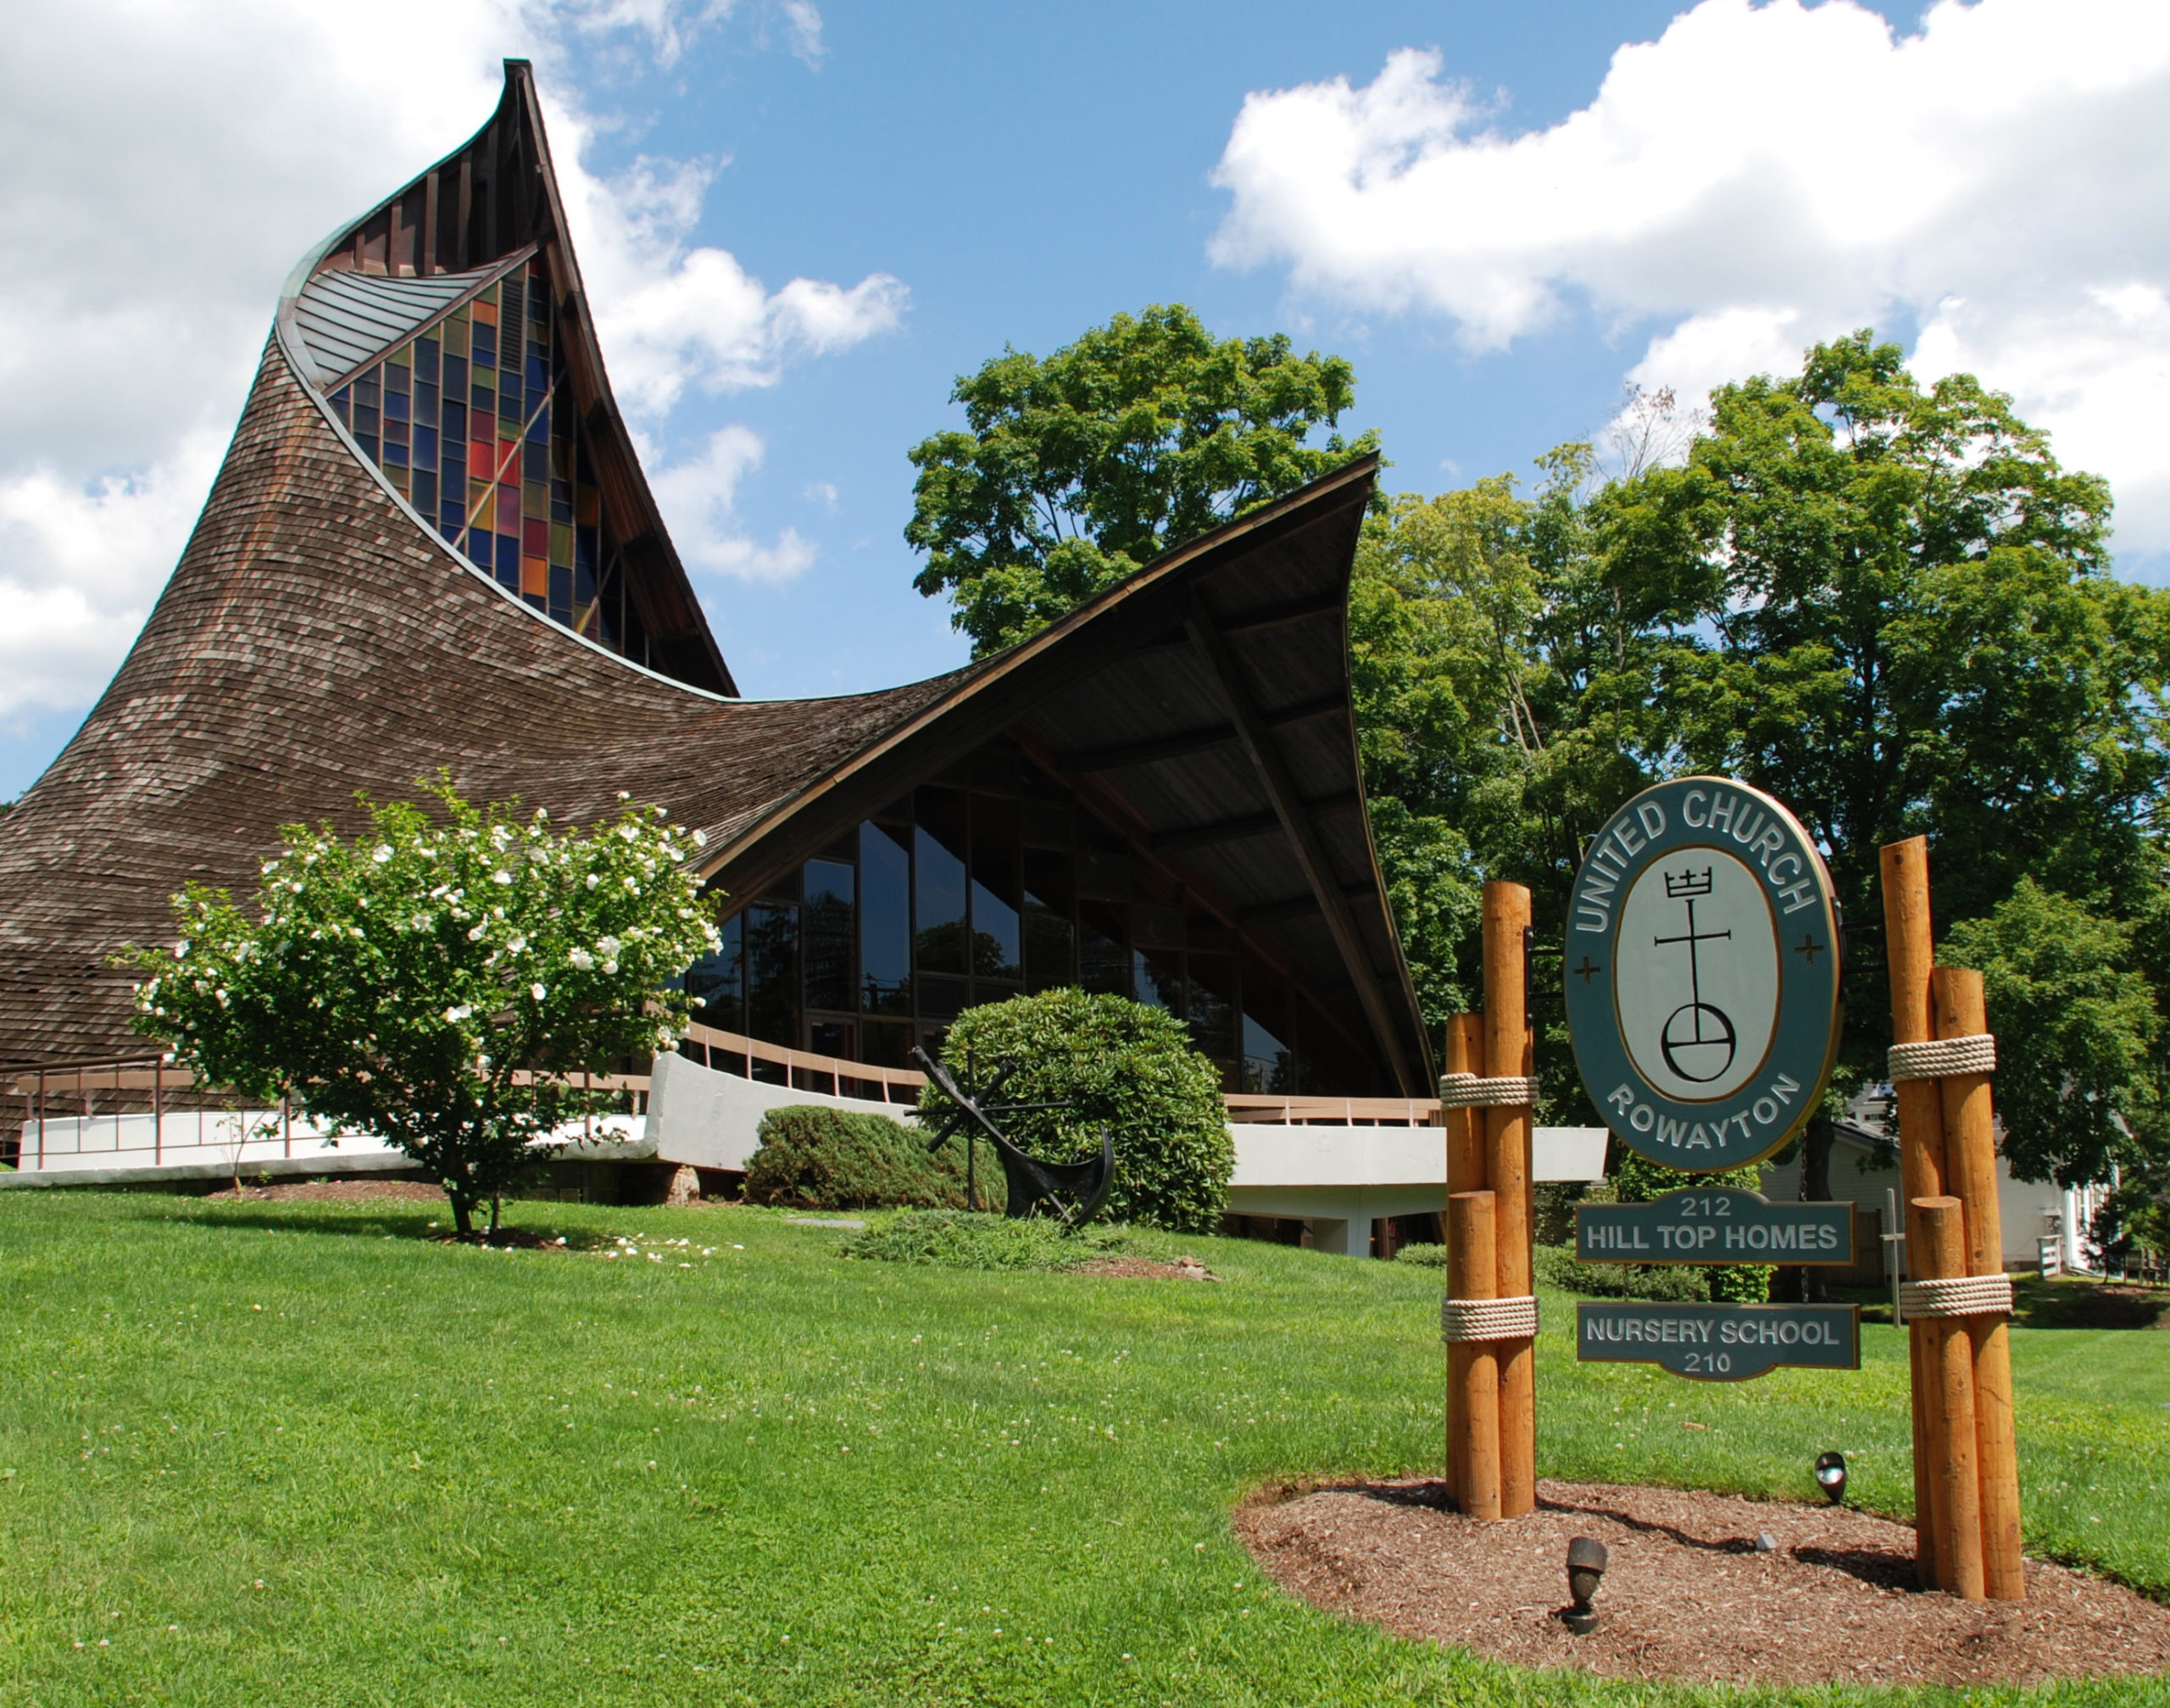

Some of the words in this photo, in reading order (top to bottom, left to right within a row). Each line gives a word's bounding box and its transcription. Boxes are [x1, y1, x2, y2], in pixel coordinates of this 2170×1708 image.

[1575, 800, 1666, 933] UNITED
[1683, 789, 1817, 915] CHURCH
[1607, 1072, 1801, 1149] ROWAYTON
[1680, 1197, 1731, 1216] 212
[1587, 1226, 1650, 1249] HILL
[1657, 1226, 1717, 1249] TOP
[1725, 1224, 1839, 1249] HOMES
[1587, 1318, 1715, 1343] NURSERY
[1720, 1320, 1839, 1345] SCHOOL
[1684, 1353, 1731, 1372] 210
